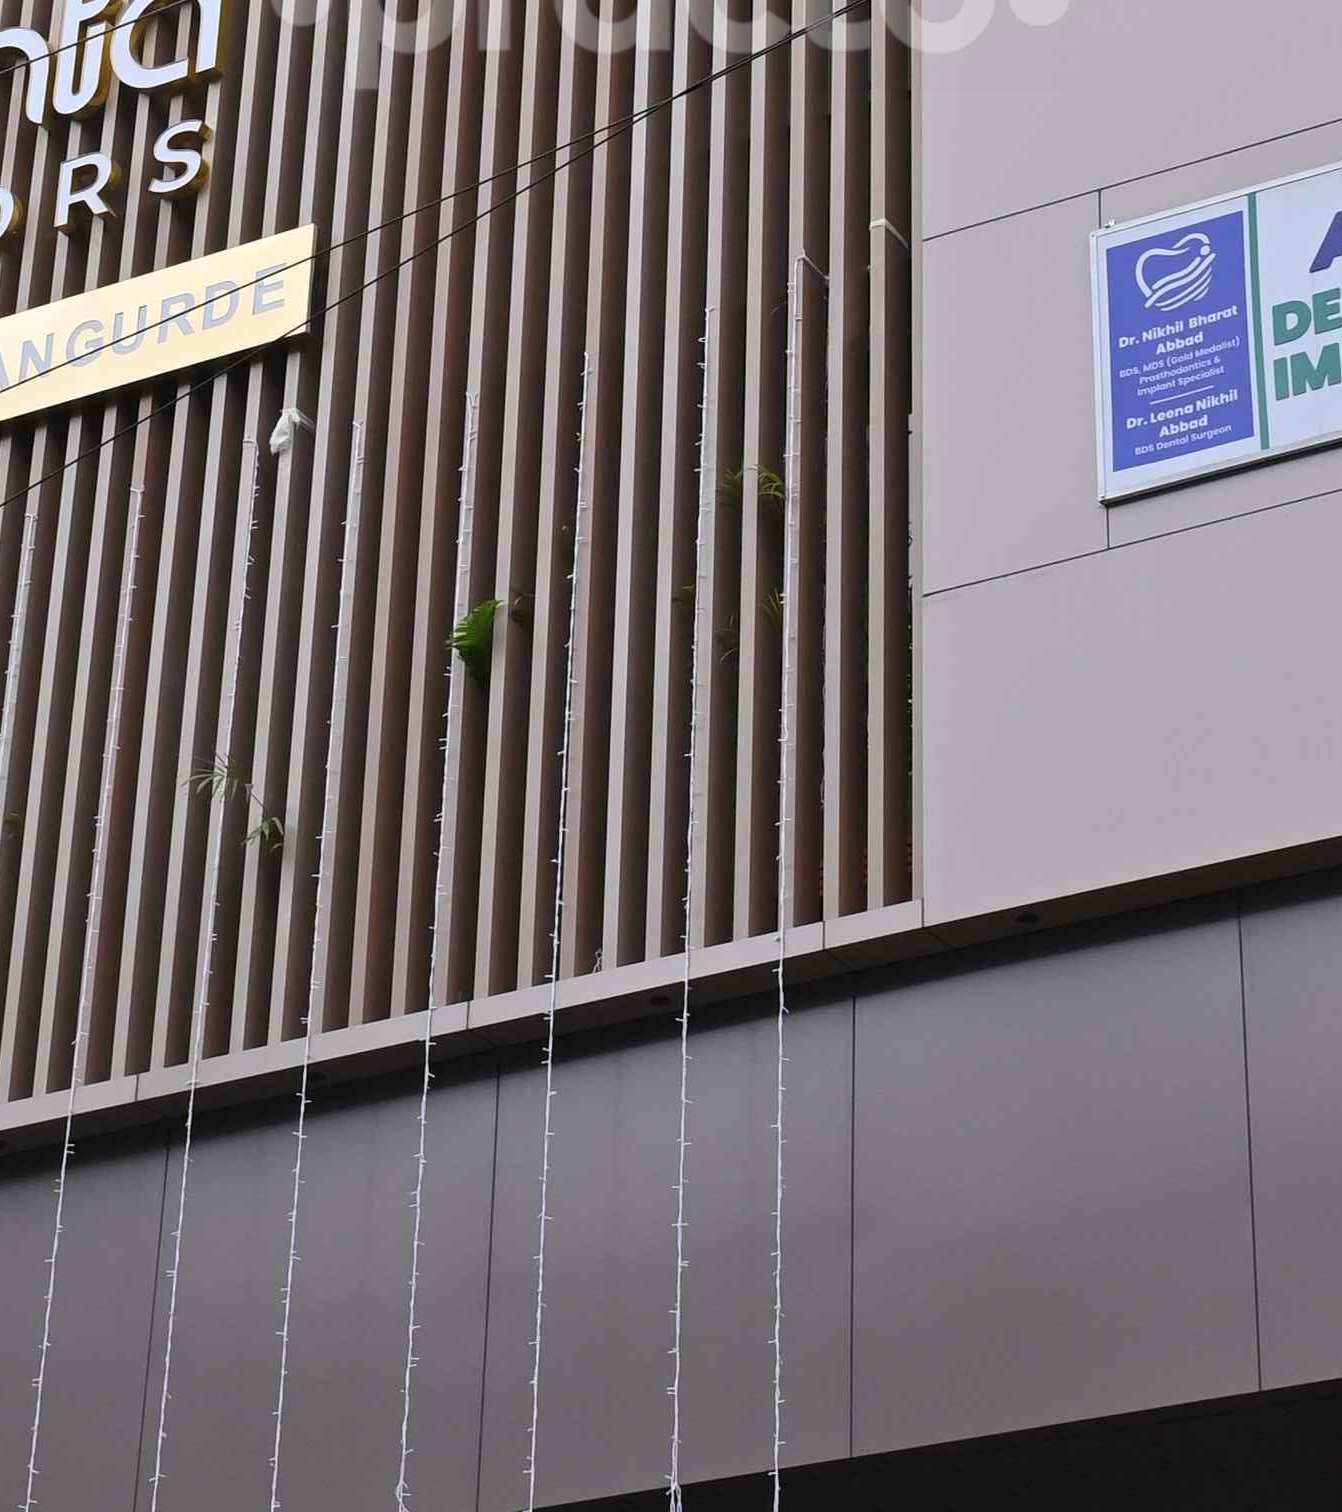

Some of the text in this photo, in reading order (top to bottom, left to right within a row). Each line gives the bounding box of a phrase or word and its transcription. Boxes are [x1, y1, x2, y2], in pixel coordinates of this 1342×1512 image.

[1118, 305, 1239, 348] Dr. Nikhil Bharat
[1156, 331, 1204, 355] Abbad
[1137, 366, 1226, 396] Implant Specialist
[1126, 388, 1239, 429] Dr. Leena Nikhil
[1134, 424, 1232, 456] BDS Dental Surgeon
[1159, 414, 1208, 438] Abbad
